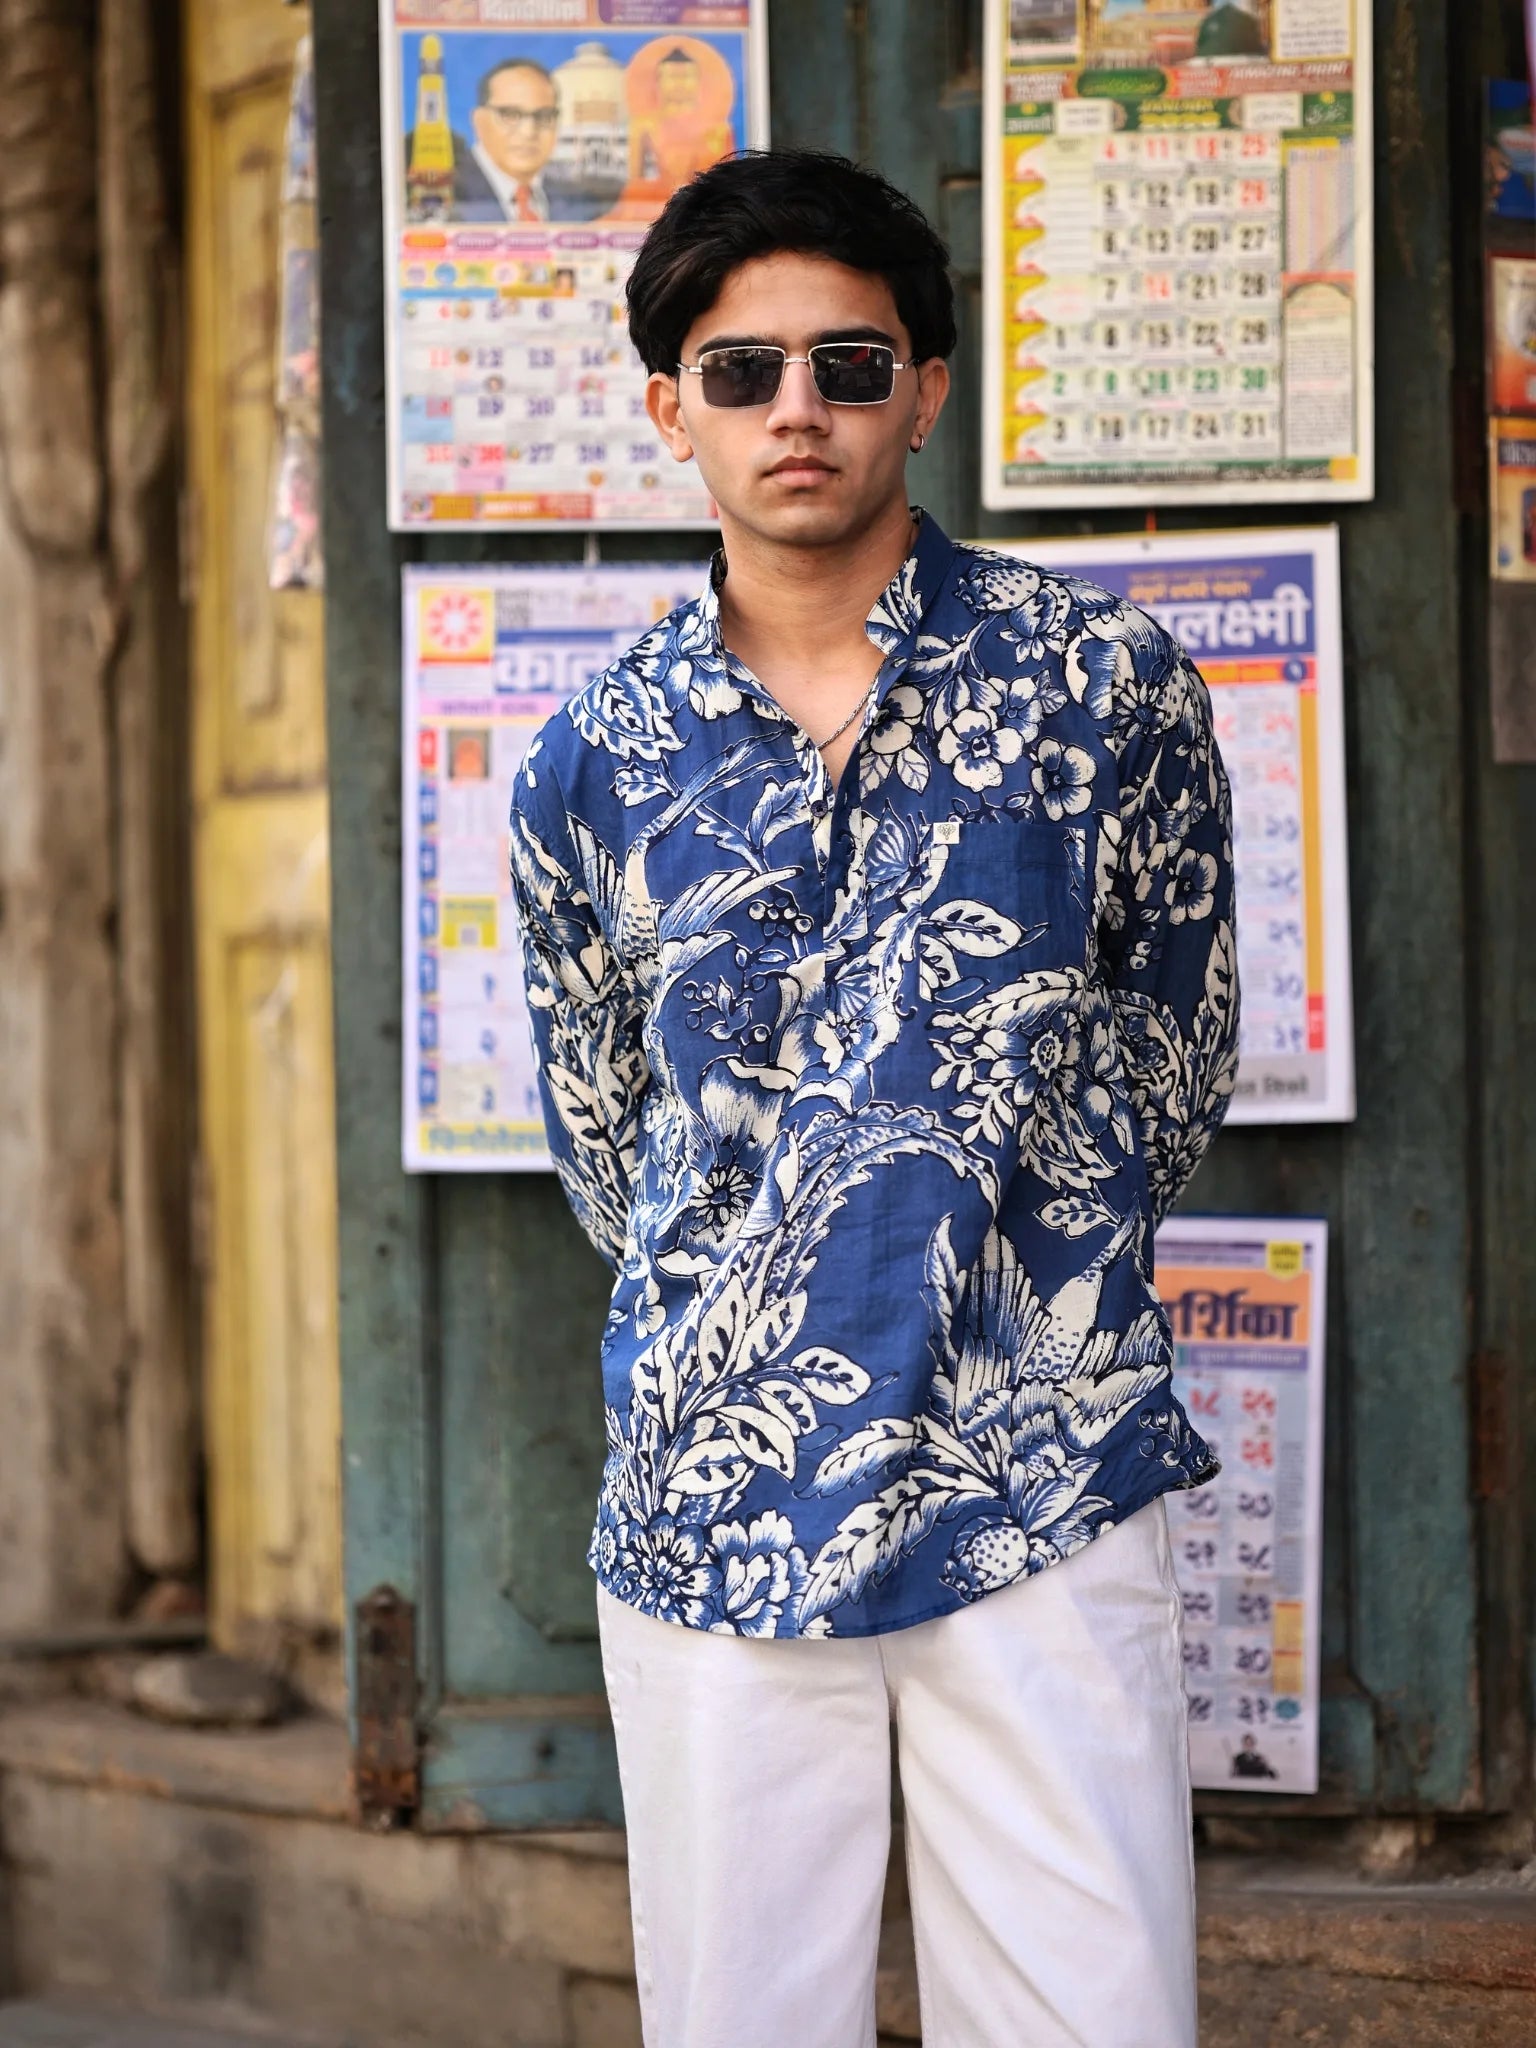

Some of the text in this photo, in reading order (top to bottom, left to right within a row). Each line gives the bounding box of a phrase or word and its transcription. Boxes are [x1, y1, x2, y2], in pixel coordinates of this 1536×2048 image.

[1146, 137, 1169, 159] 11
[1241, 134, 1267, 157] 25
[1146, 182, 1169, 207] 12
[1146, 228, 1169, 253] 13
[1192, 227, 1219, 252] 20
[1240, 226, 1266, 250] 27
[1106, 276, 1118, 301] 7
[1192, 275, 1217, 299] 21
[1241, 273, 1265, 297] 28
[1056, 325, 1065, 349] 1
[1148, 324, 1170, 347] 15
[1193, 322, 1219, 346] 22
[1241, 320, 1267, 344] 29
[1053, 371, 1066, 395] 2
[1193, 369, 1220, 392] 23
[1241, 367, 1267, 391] 30
[1054, 414, 1265, 441] 3 10 17 24 31
[529, 443, 555, 463] 27
[1163, 1287, 1300, 1340] र्शिका
